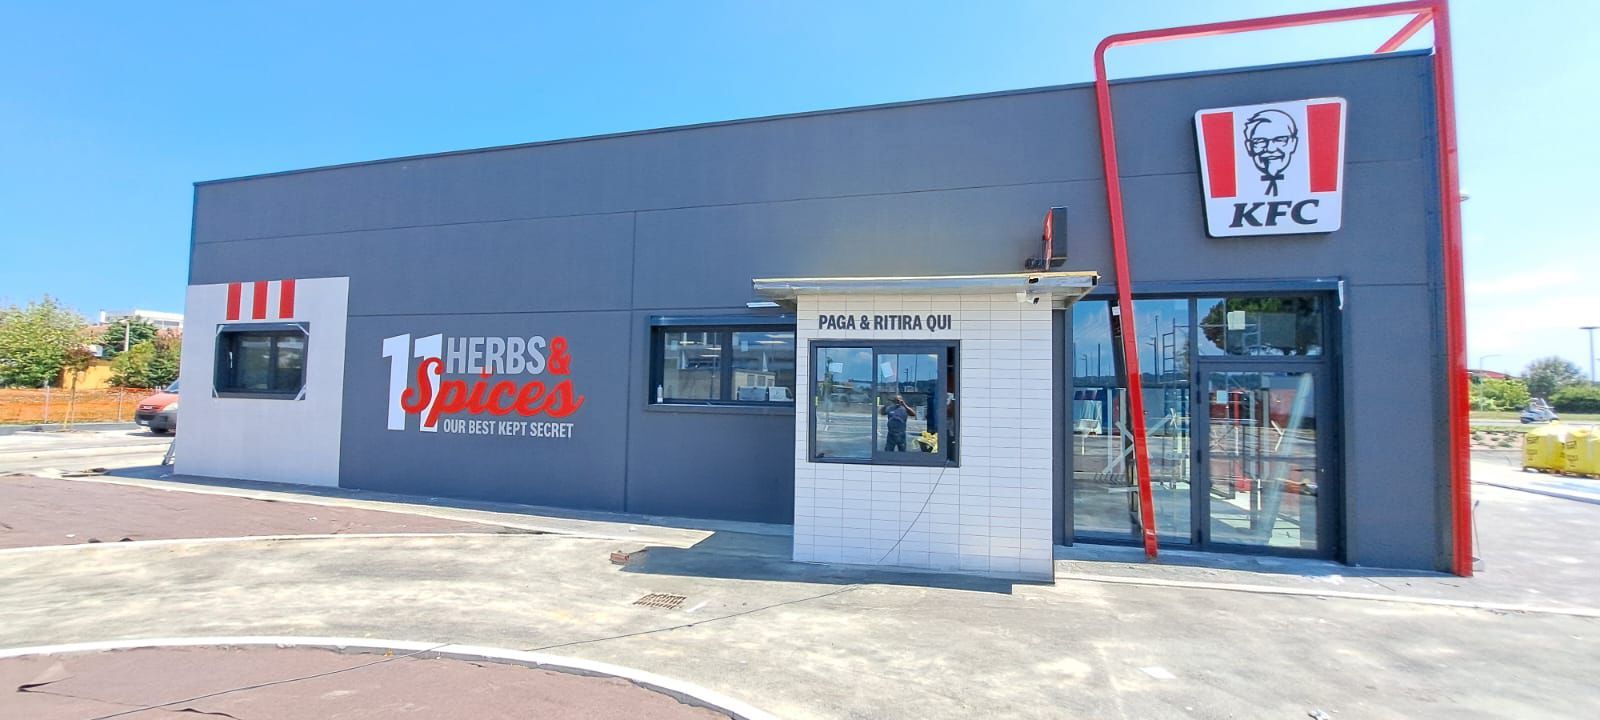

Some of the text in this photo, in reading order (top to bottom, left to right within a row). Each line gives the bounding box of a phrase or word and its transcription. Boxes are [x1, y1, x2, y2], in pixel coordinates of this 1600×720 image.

[1228, 199, 1320, 228] KFC
[818, 314, 952, 332] PAGA & RITIRA QUI
[382, 333, 443, 433] 11
[446, 335, 547, 375] HERBS
[401, 357, 584, 427] Spices
[443, 418, 575, 439] OUR BEST KEPT SECRET
